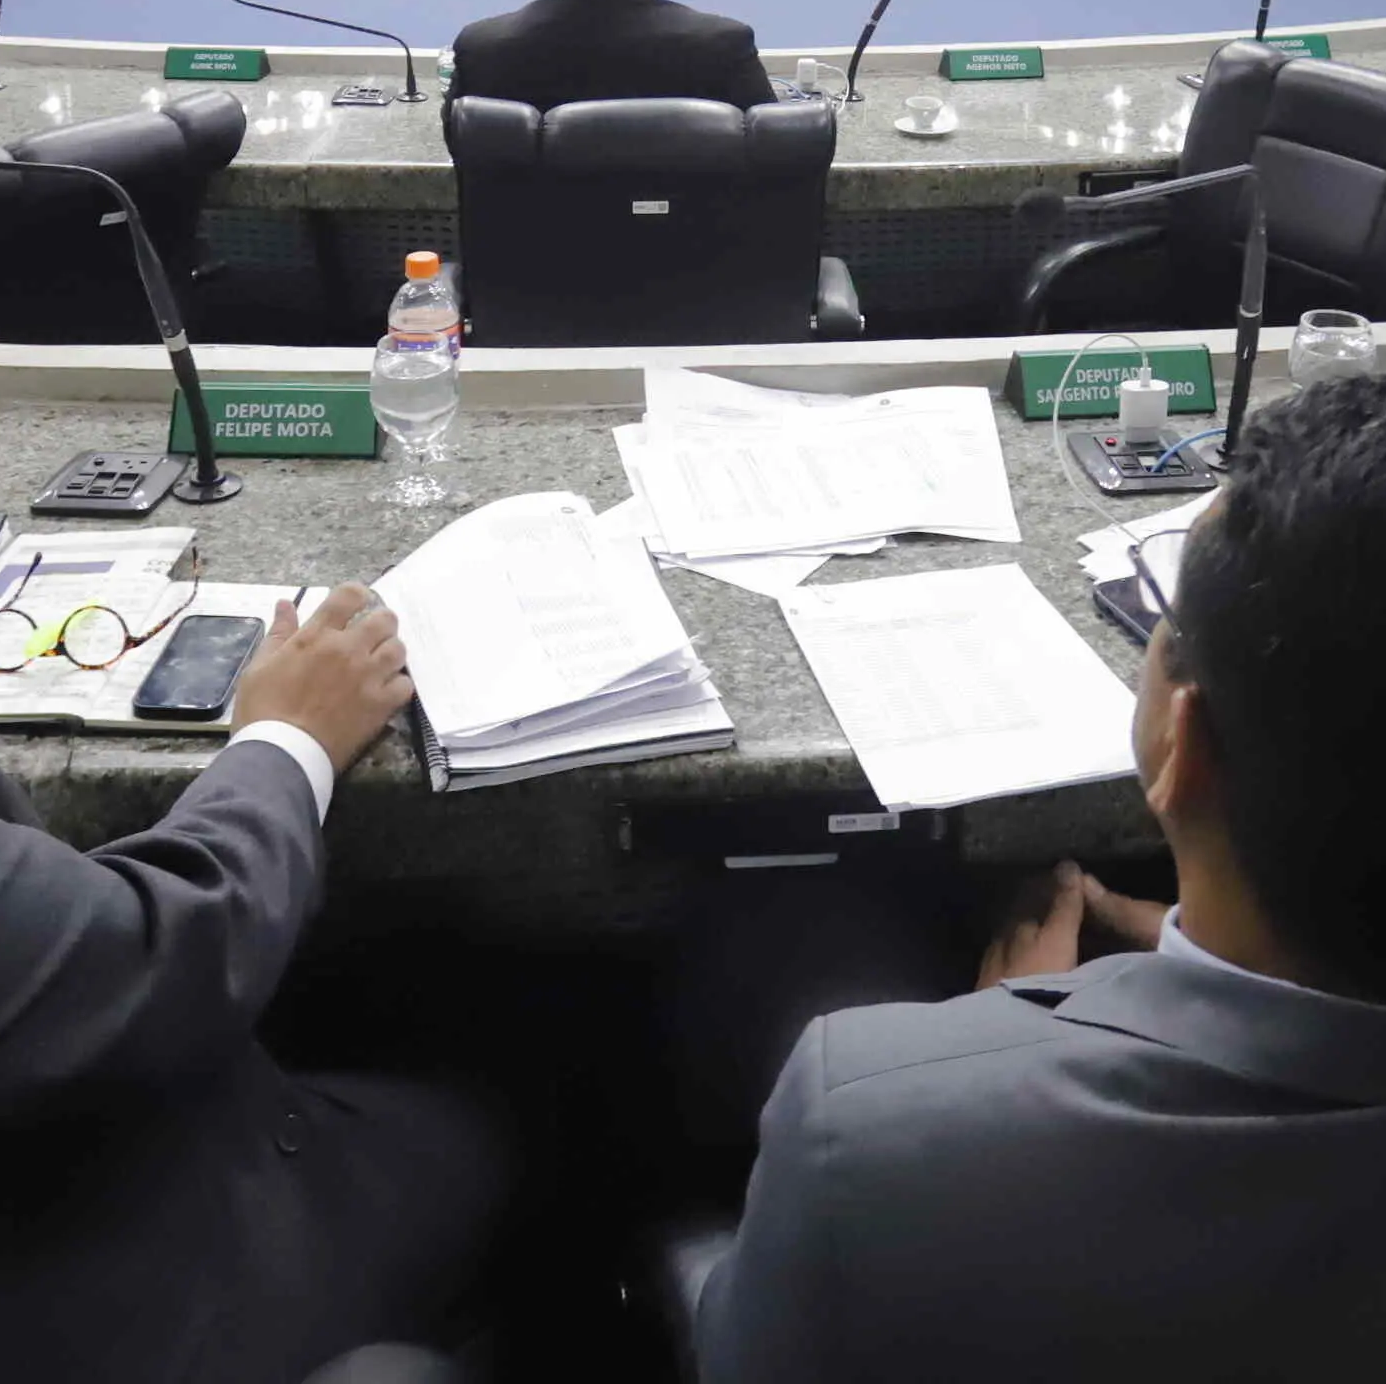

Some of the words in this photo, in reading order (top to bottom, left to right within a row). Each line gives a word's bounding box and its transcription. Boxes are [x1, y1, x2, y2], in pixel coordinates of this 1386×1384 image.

[972, 54, 1019, 63] DEPUTADO
[1004, 62, 1027, 70] NETO
[1076, 367, 1141, 383] DEPUTAD
[1036, 385, 1111, 404] SARGENTO
[225, 403, 326, 419] DEPUTADO
[215, 422, 273, 437] FELIPE
[277, 422, 334, 437] MOTA
